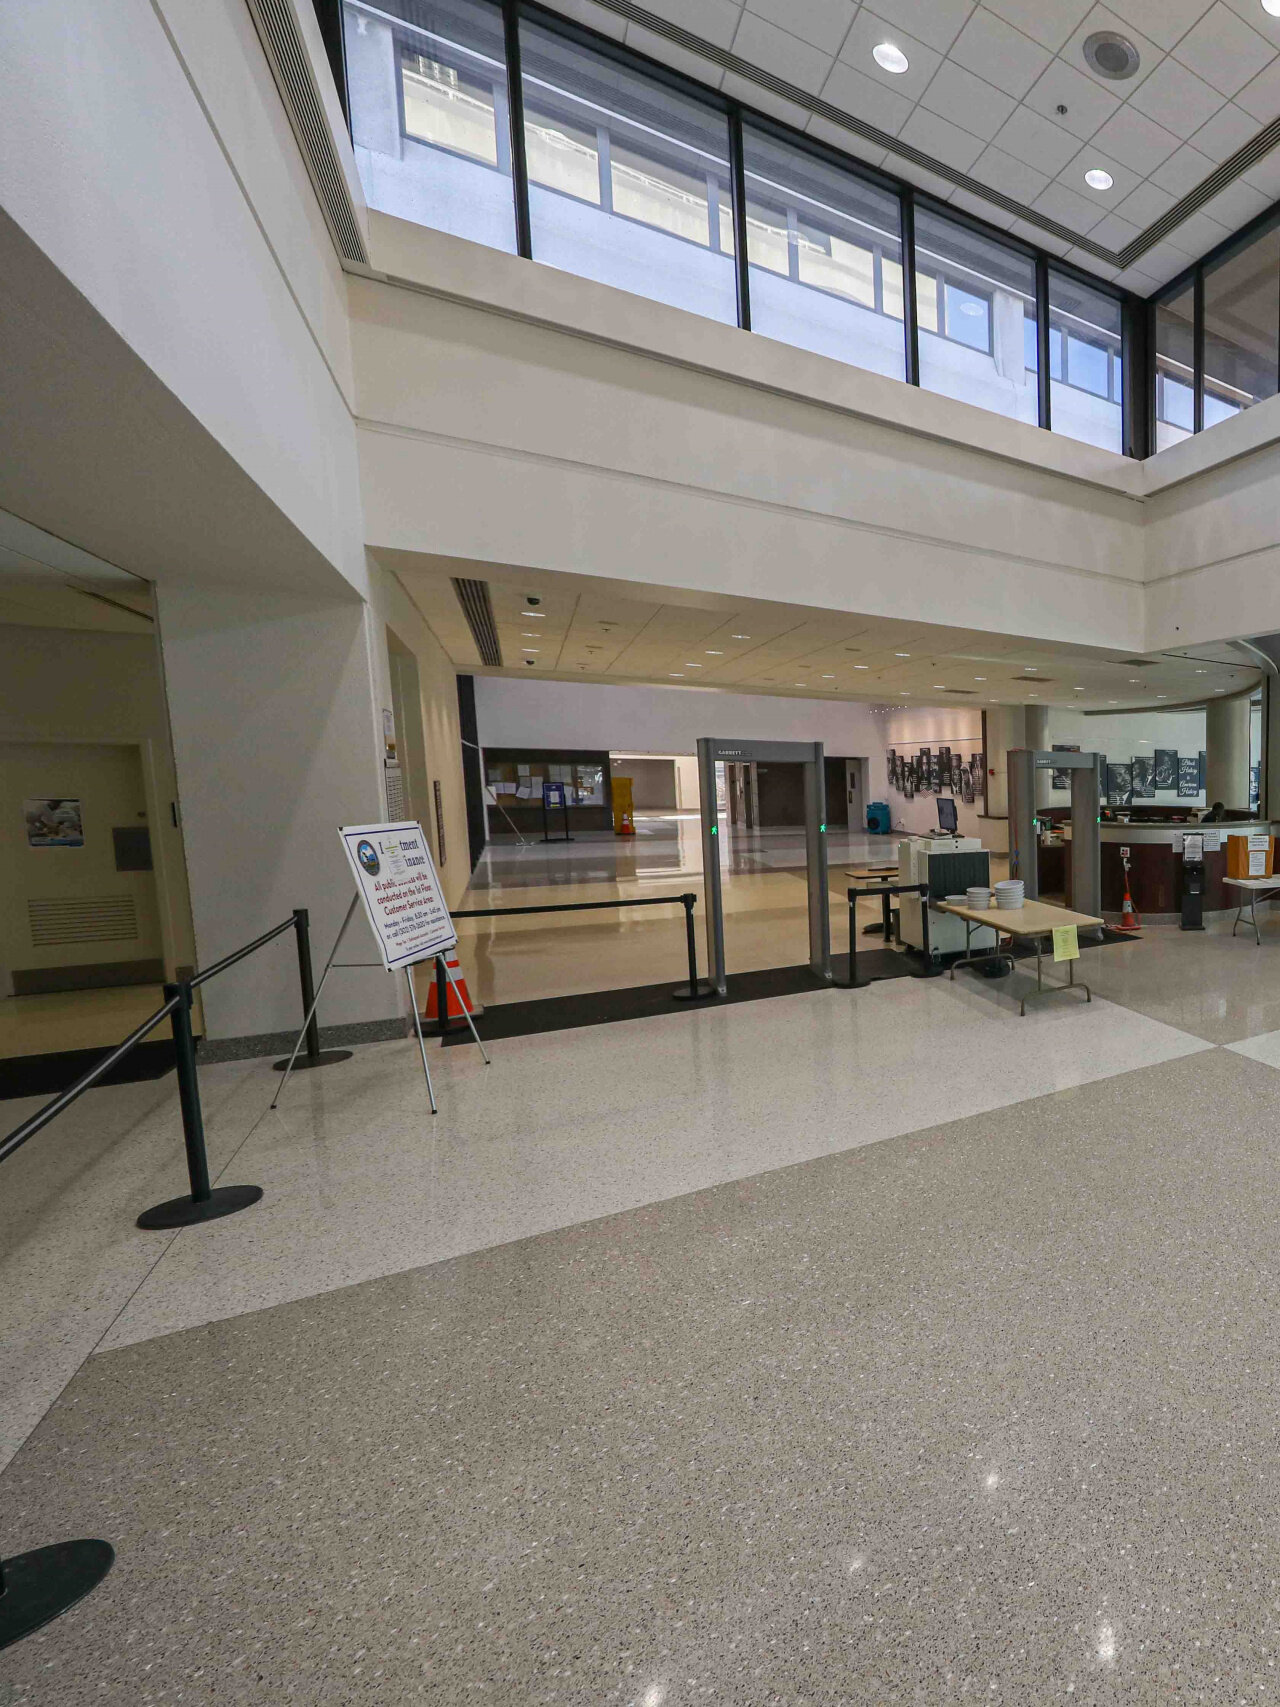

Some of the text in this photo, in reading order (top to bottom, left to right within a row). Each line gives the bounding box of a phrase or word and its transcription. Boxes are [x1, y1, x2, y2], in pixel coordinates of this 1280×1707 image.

[404, 855, 426, 868] inance
[377, 889, 403, 905] conducted
[384, 905, 408, 915] Customer
[407, 898, 424, 909] Service
[384, 920, 400, 930] Monday
